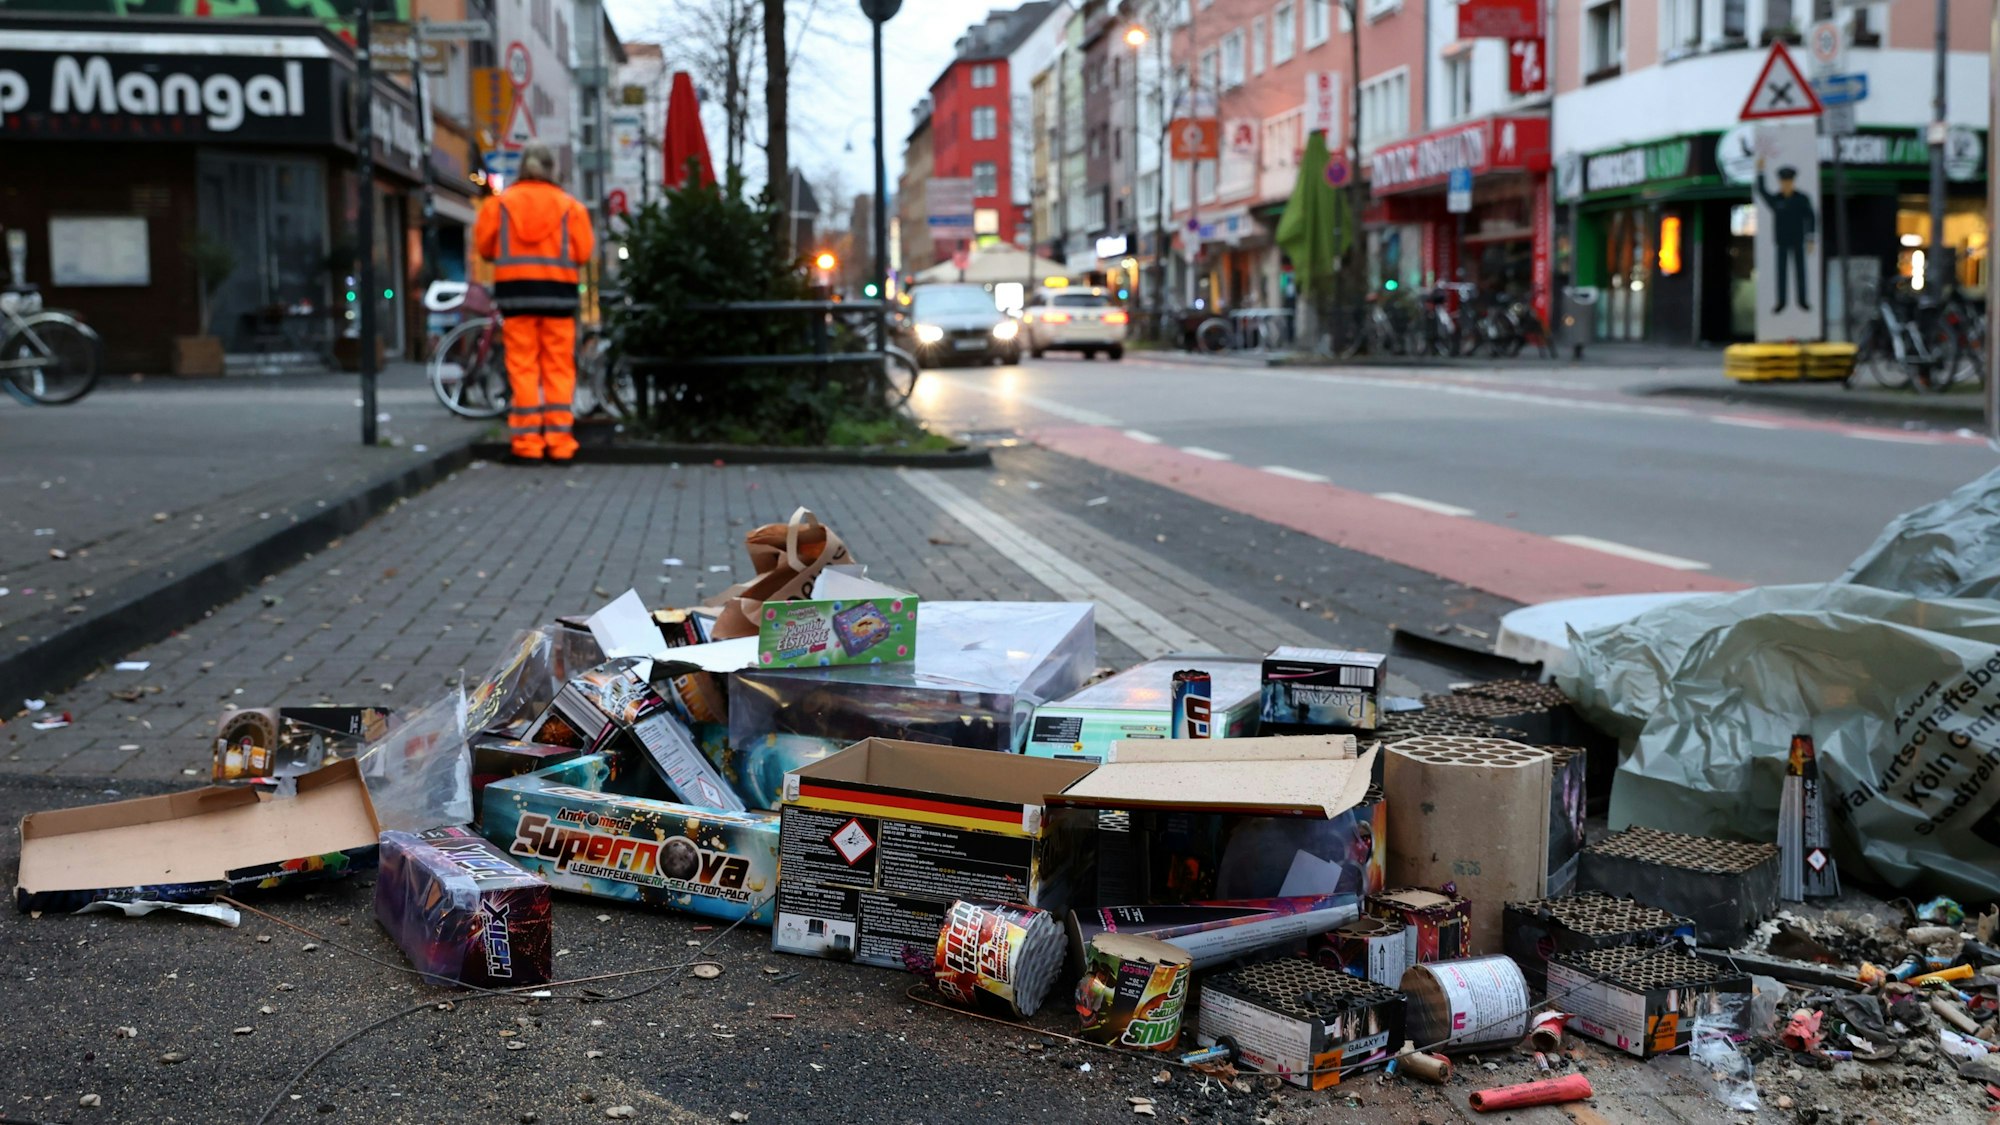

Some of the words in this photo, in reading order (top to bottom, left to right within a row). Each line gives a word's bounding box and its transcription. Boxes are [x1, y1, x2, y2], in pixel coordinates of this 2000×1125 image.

[50, 55, 304, 132] Mangal
[1902, 751, 1958, 808] Köln
[1946, 690, 2000, 750] Gmb
[1914, 738, 2000, 836] Stadtrein
[510, 812, 751, 889] Supernova
[556, 807, 633, 832] Andromeda
[570, 862, 752, 902] LEUCHTFEUERWERK-SELECTION-PACK
[1348, 1037, 1379, 1053] GALAXY
